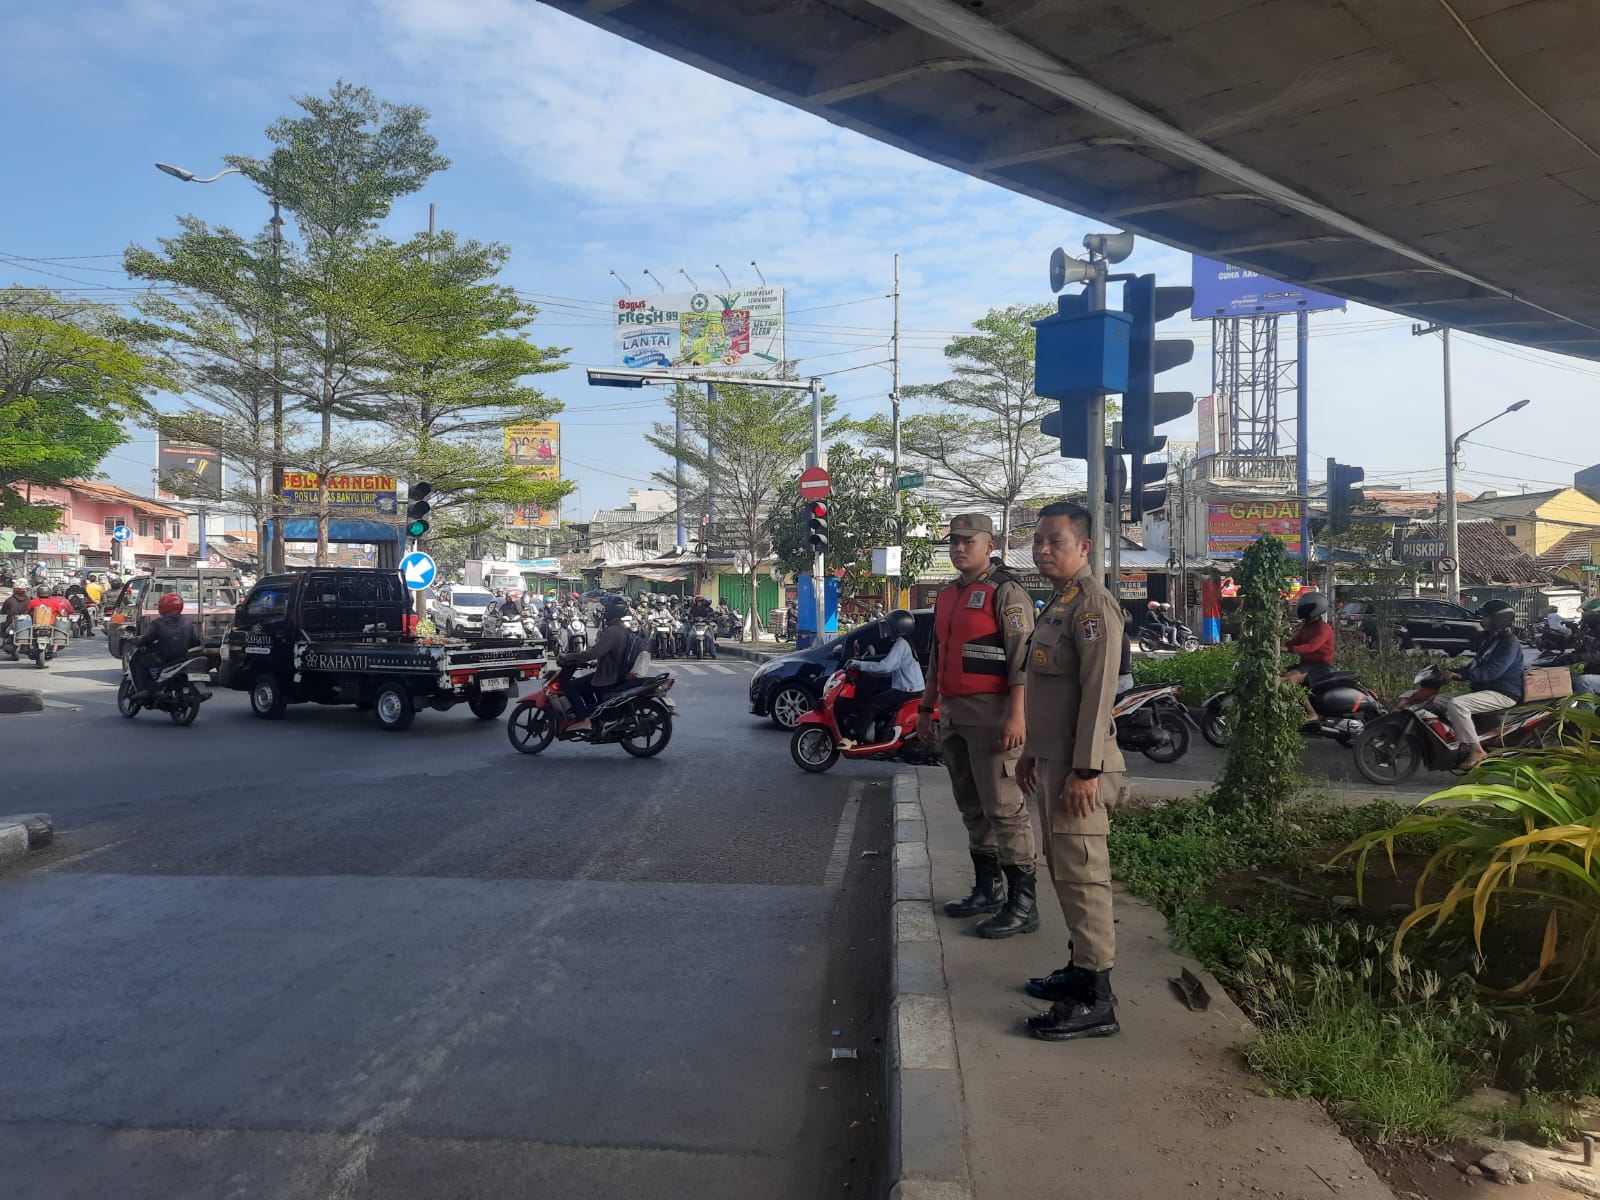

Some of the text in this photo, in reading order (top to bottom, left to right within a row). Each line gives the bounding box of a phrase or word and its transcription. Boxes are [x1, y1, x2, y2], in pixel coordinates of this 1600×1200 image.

[753, 319, 778, 327] ULTRA
[751, 327, 771, 336] CLEAN
[623, 336, 670, 350] LANTAI
[294, 492, 307, 502] POS
[309, 492, 335, 502] LAAS
[336, 492, 358, 502] BANYU
[1229, 502, 1300, 519] GADAI
[1403, 543, 1445, 556] PUSKRIP
[245, 633, 271, 644] RAHAYU
[319, 655, 368, 670] RAHAYU
